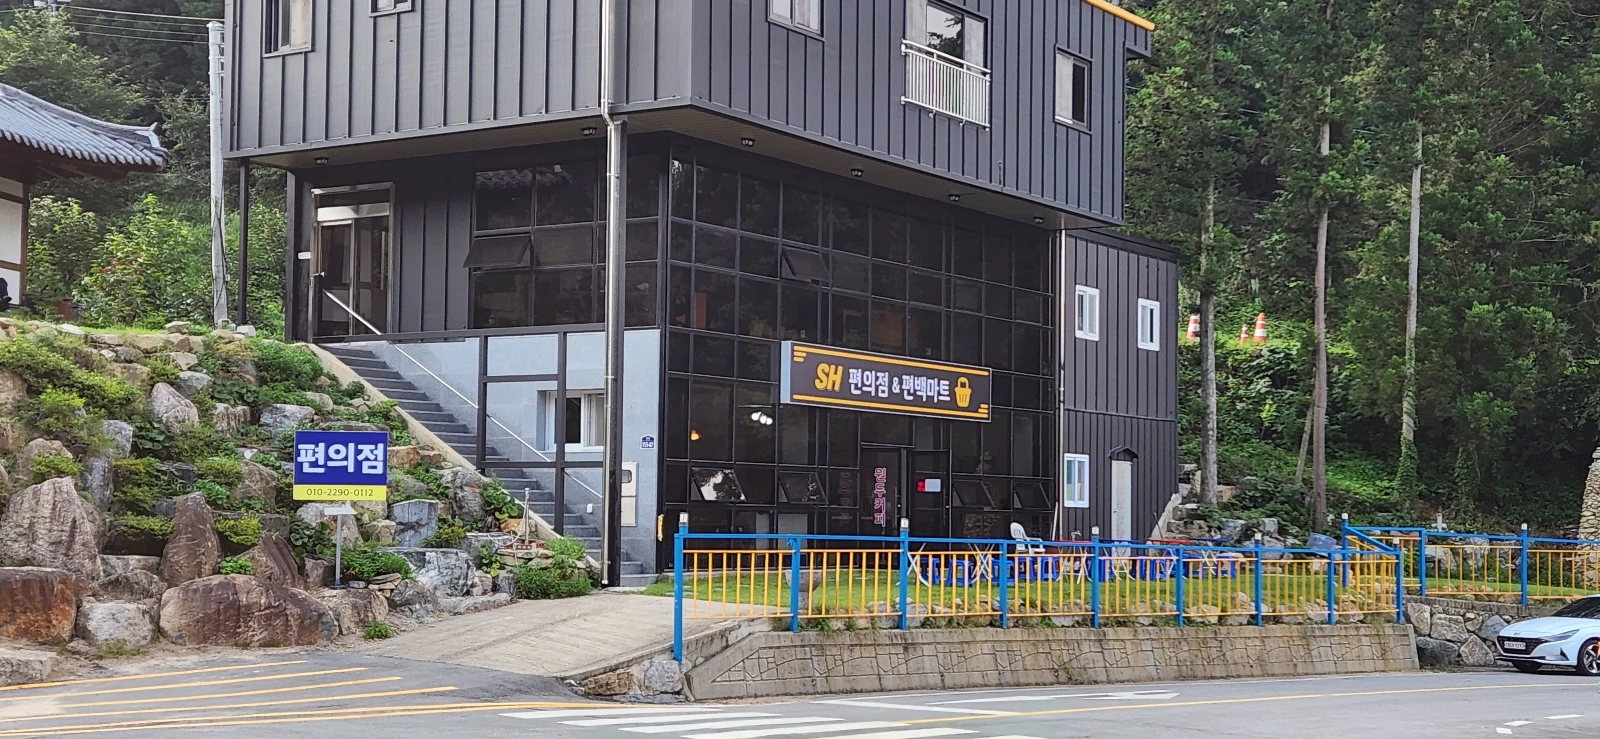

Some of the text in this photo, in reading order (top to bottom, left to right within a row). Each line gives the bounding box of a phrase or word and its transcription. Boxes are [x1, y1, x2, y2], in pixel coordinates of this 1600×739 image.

[814, 362, 844, 392] SH
[848, 368, 889, 397] 편의점
[901, 374, 951, 404] 편백마트
[297, 442, 384, 474] 편의점
[306, 488, 374, 497] 010-2290-0112
[874, 467, 887, 528] 원두커피
